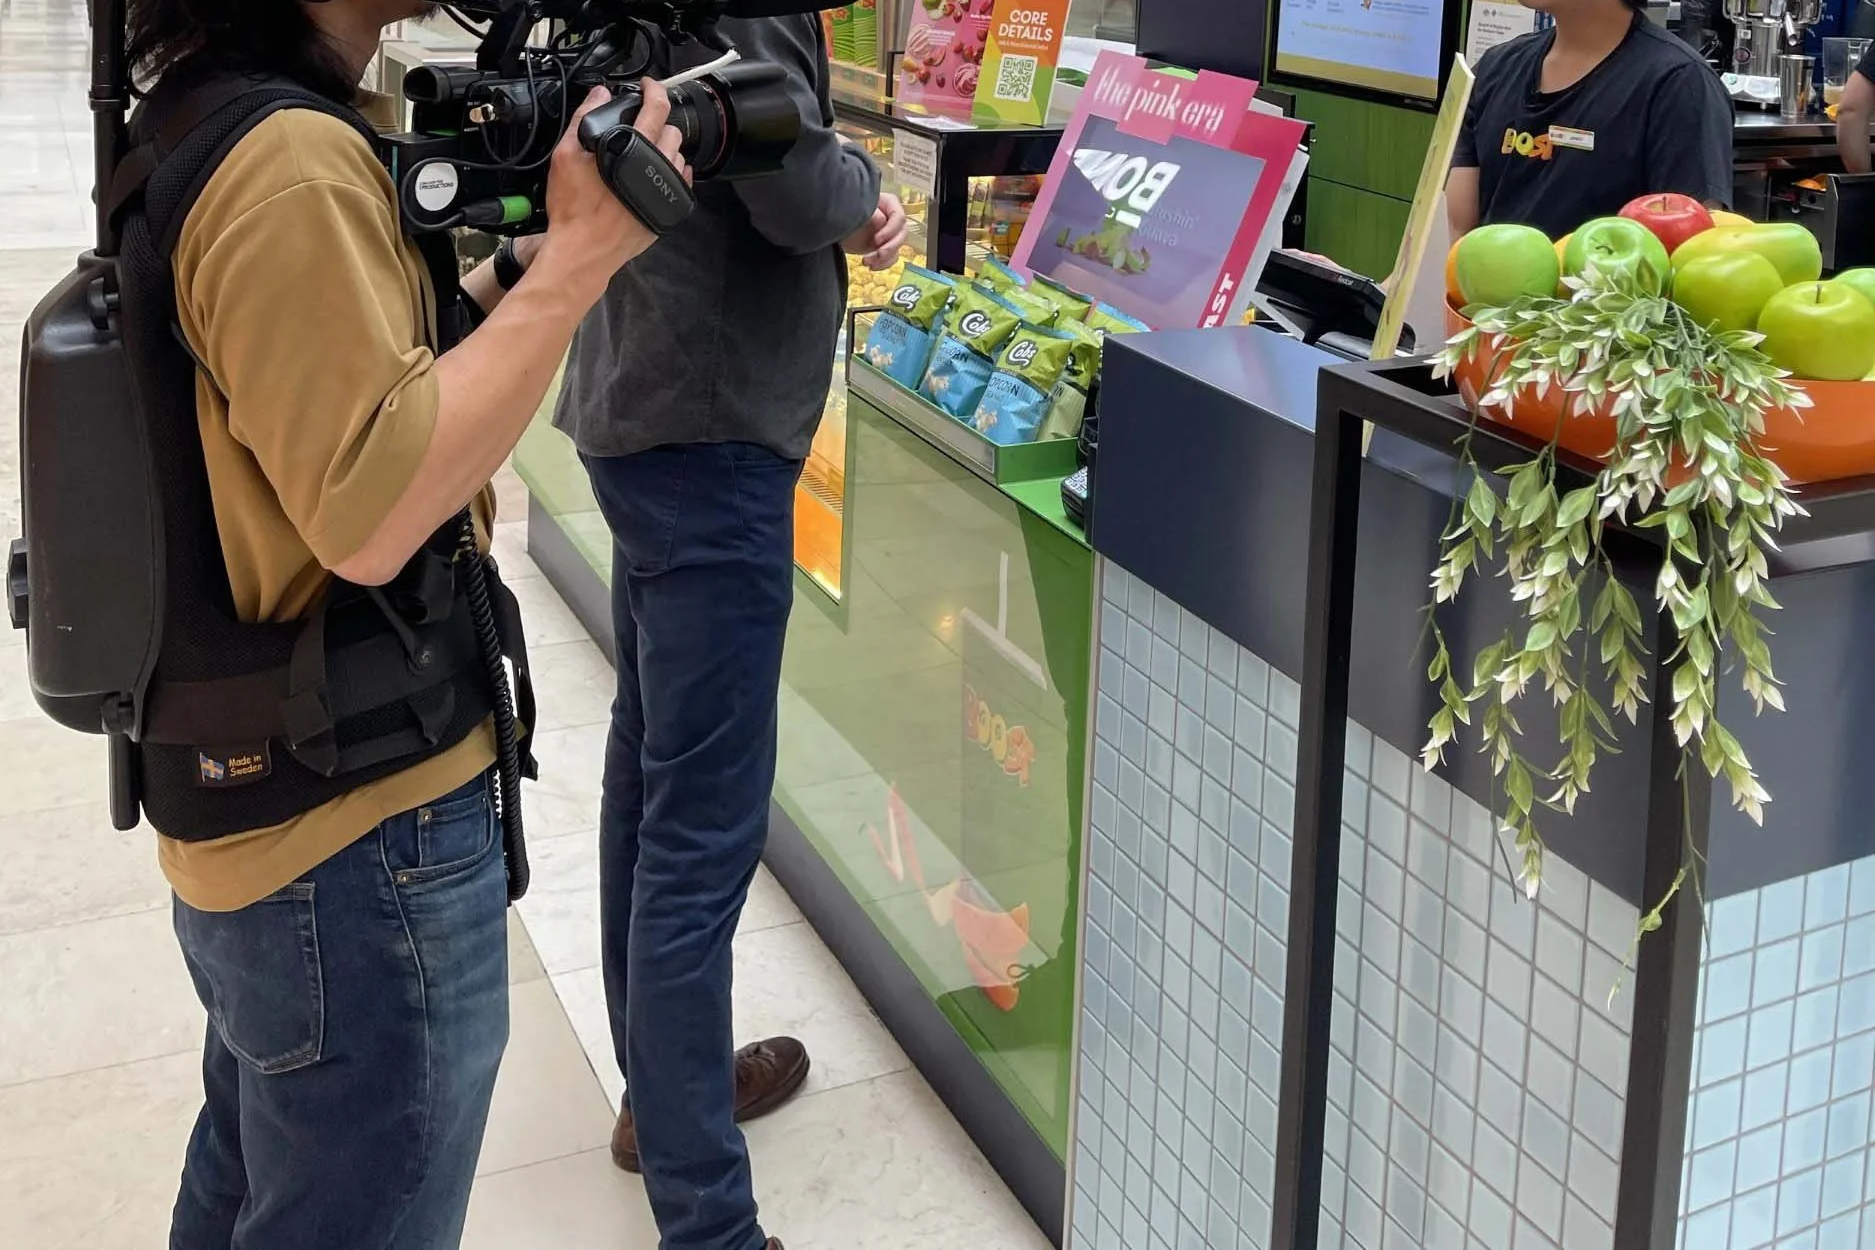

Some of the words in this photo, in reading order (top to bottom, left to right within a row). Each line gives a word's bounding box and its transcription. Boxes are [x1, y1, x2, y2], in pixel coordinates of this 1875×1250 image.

[1009, 9, 1049, 25] CORE
[998, 22, 1053, 42] DETAILS
[1124, 78, 1183, 121] pink
[1181, 100, 1226, 137] era
[645, 165, 678, 203] SONY
[893, 284, 921, 310] Cobs
[961, 312, 991, 337] Cobs
[1008, 341, 1037, 367] Cobs
[988, 376, 1020, 397] OPCORN
[228, 755, 251, 768] Made
[253, 755, 262, 763] in
[230, 764, 263, 777] Sweden
